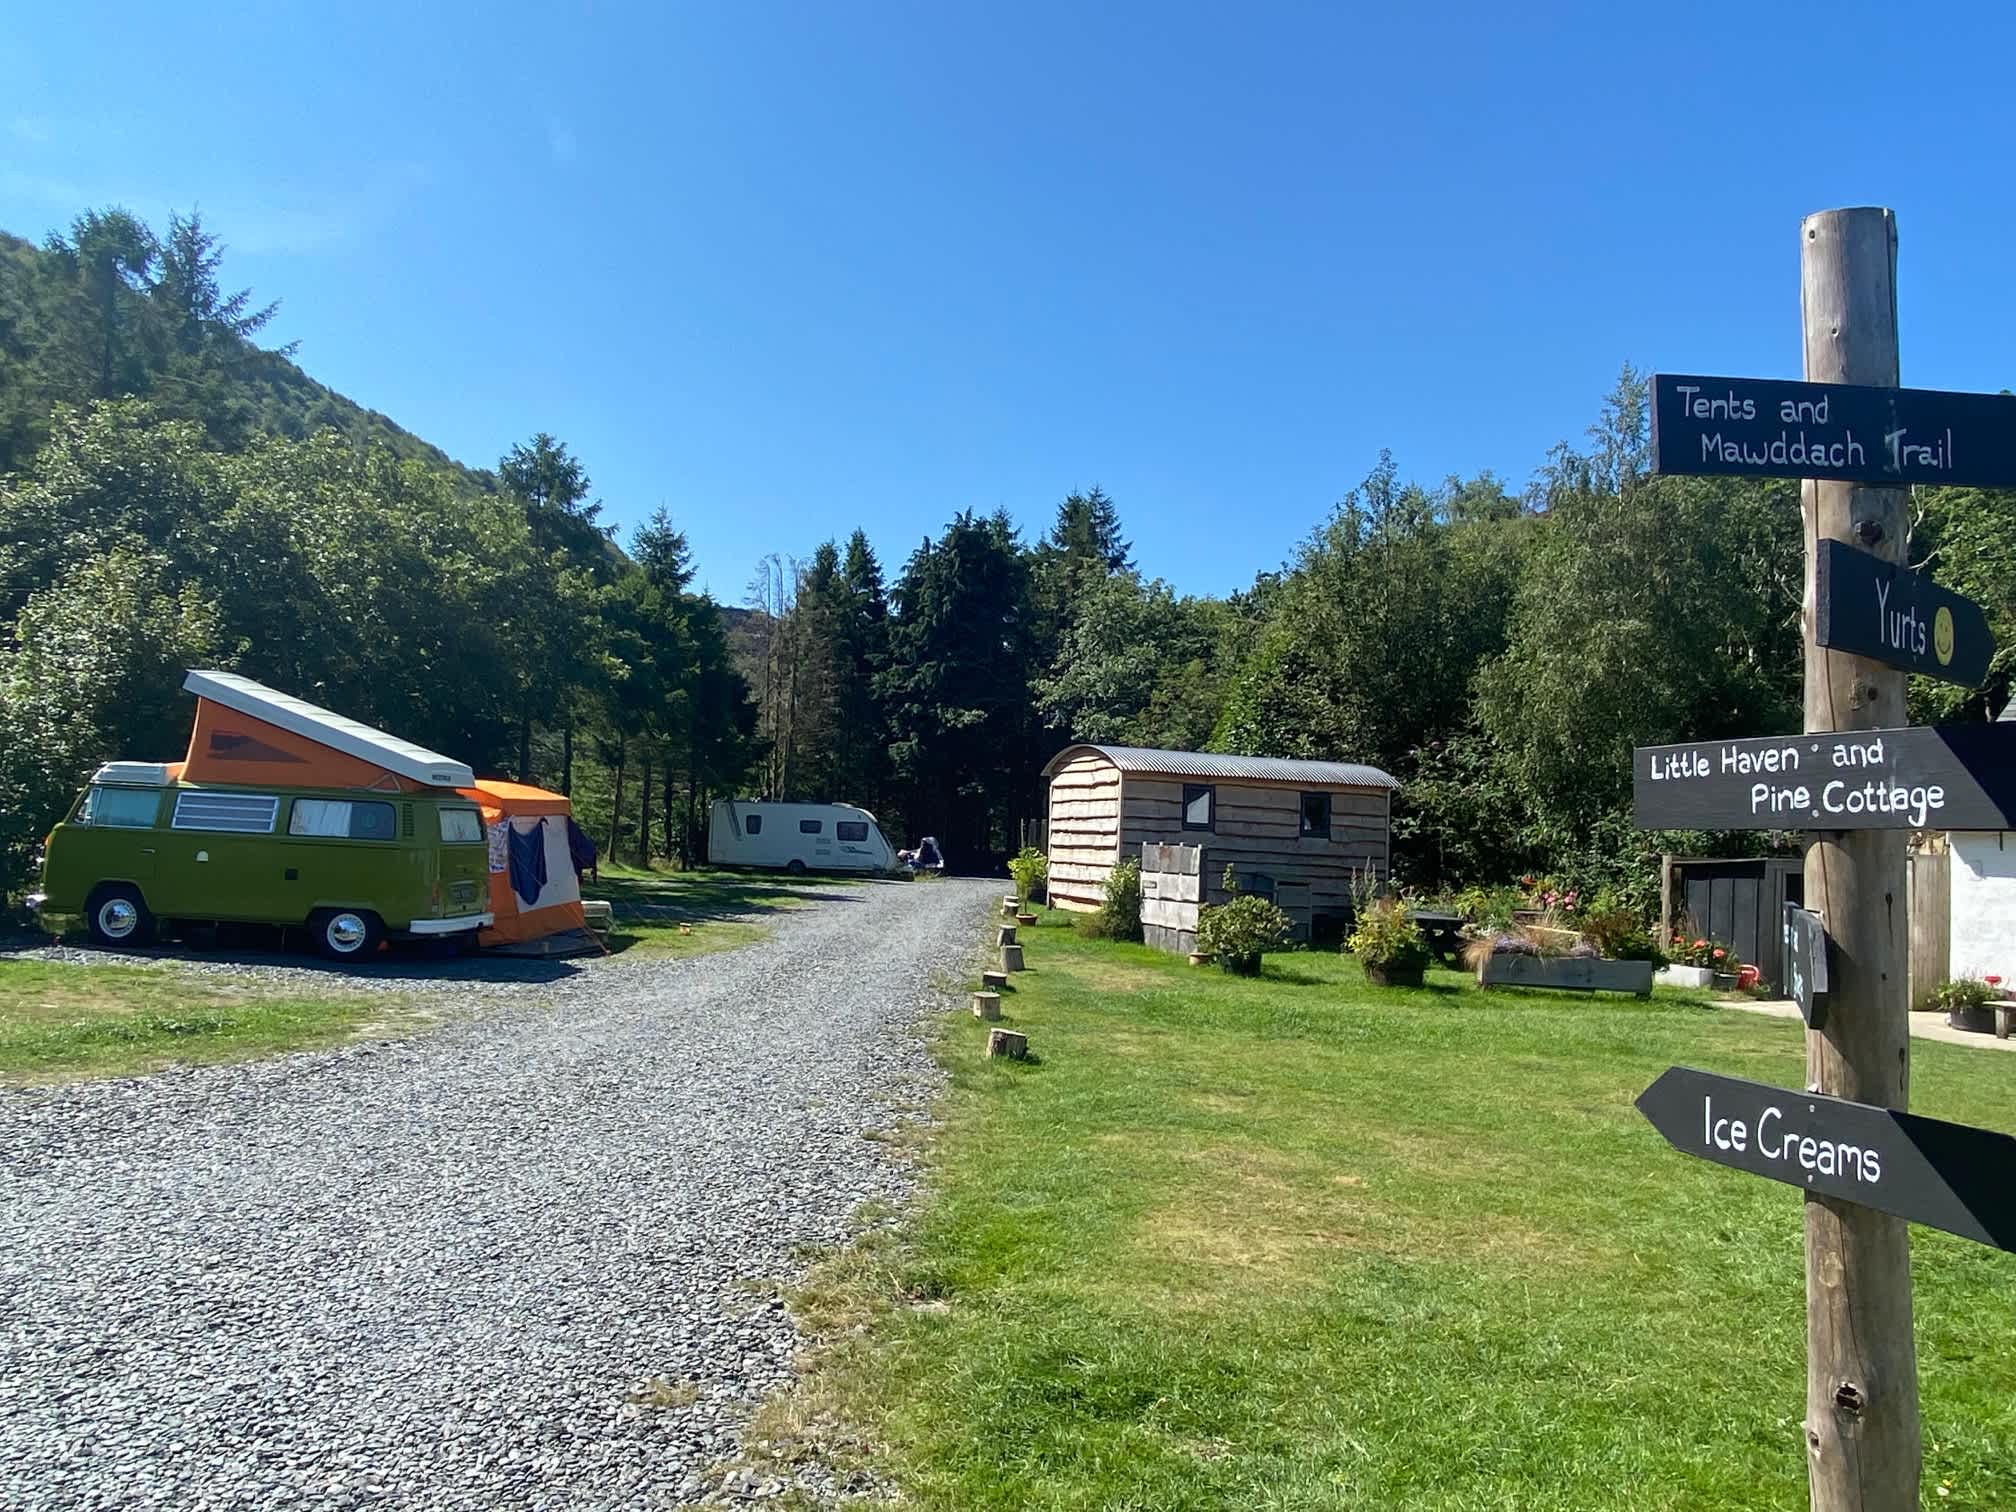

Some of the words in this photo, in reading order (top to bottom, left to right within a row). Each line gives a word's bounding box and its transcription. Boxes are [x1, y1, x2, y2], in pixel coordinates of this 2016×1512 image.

[1676, 385, 1756, 420] Tents
[1780, 394, 1829, 424] and
[1701, 430, 1866, 467] Mawddach
[1885, 428, 1952, 470] Trail
[1875, 577, 1926, 656] Yurts
[1650, 751, 1710, 780] Little
[1721, 745, 1799, 774] Haven
[1831, 737, 1884, 768] and
[1751, 784, 1810, 815] Pine
[1822, 780, 1945, 826] Cottage
[1705, 1096, 1747, 1152] Ice
[1757, 1107, 1881, 1183] Creams
